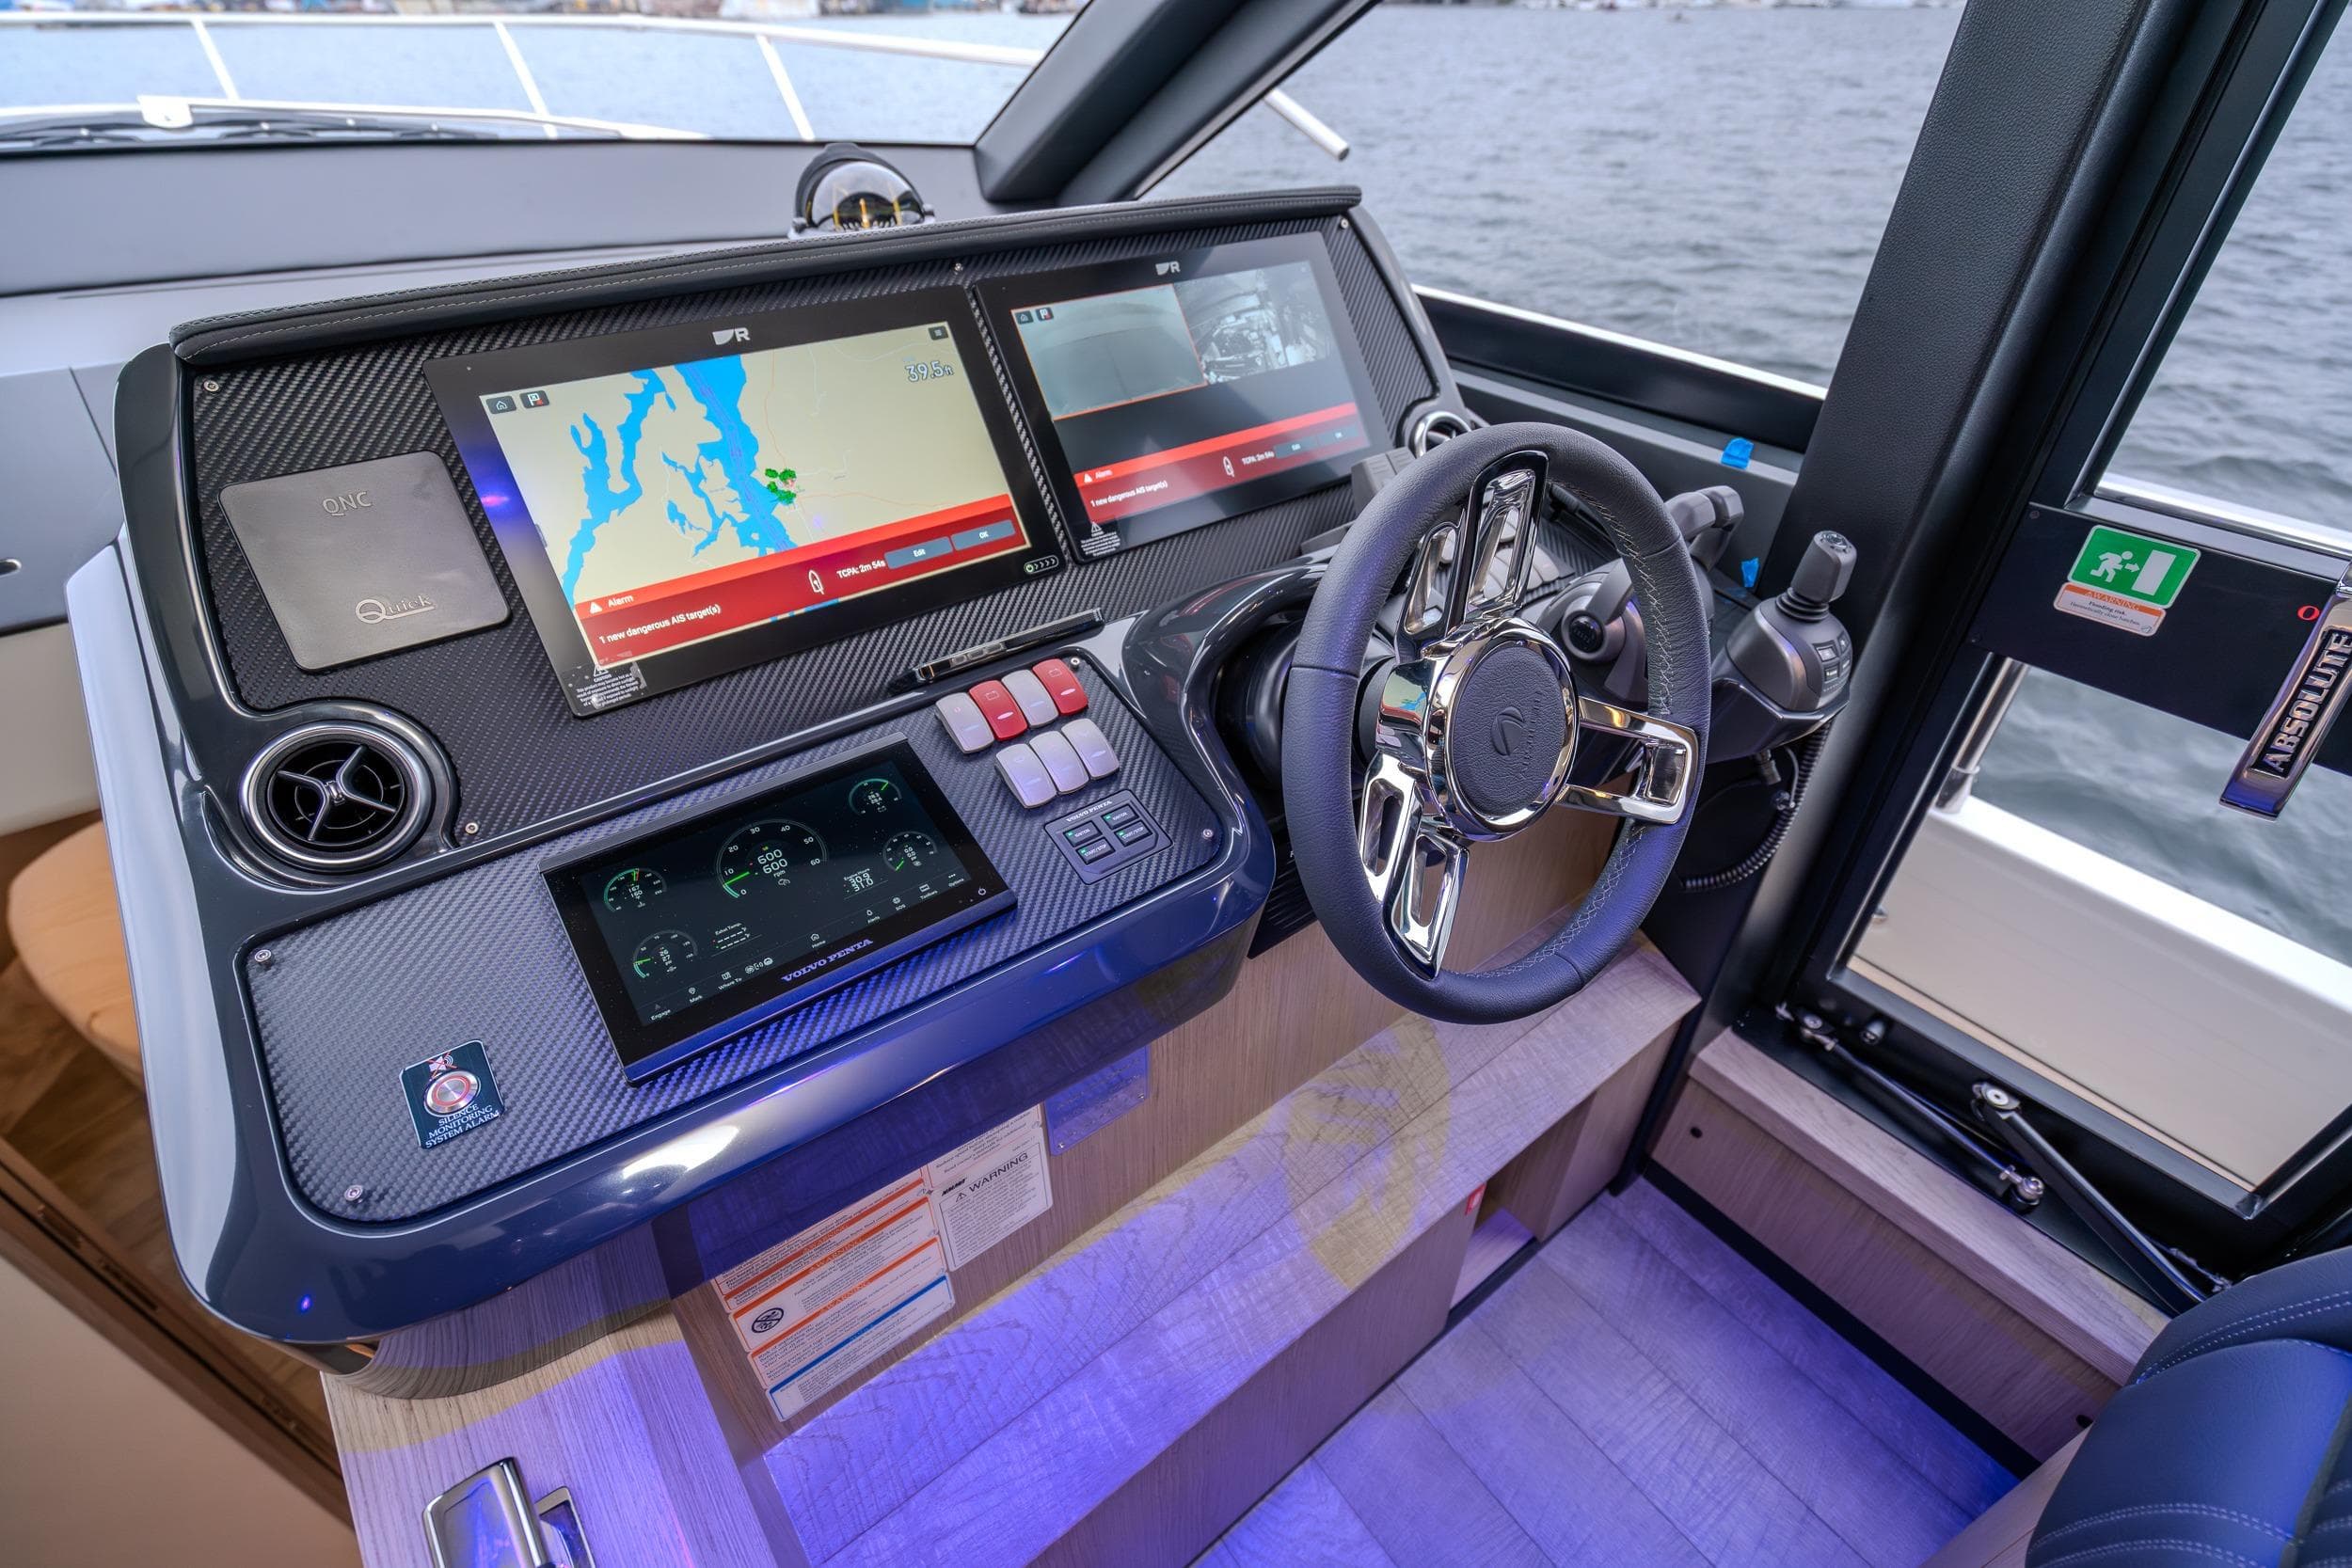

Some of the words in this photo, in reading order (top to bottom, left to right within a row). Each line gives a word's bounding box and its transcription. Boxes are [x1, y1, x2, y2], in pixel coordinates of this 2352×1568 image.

[1095, 469, 1113, 480] Alarm
[323, 491, 372, 516] QNC
[1108, 489, 1136, 503] dangerous
[913, 547, 926, 558] Edit
[836, 566, 860, 579] TCPA:
[860, 564, 872, 574] 2m
[871, 559, 886, 570] 54s
[608, 594, 633, 608] Alarm
[2091, 593, 2139, 610] WARNING
[356, 595, 436, 624] Quick
[599, 636, 606, 644] 1
[608, 632, 626, 642] new
[626, 619, 671, 638] dangerous
[671, 613, 686, 626] AIS
[686, 604, 722, 621] target(s)
[2262, 633, 2352, 773] ABSOLUTE
[1066, 810, 1089, 822] VOLVO
[1089, 800, 1112, 813] PENTA
[803, 836, 814, 845] 50
[757, 849, 783, 864] 600
[724, 868, 734, 877] 10
[762, 859, 788, 874] 600
[773, 869, 786, 878] rpm
[812, 940, 826, 948] Home
[782, 958, 827, 982] VOLVO
[827, 939, 873, 962] PENTA
[718, 980, 735, 990] Where
[690, 994, 703, 1003] Mark
[650, 1009, 671, 1021] Engage
[428, 1104, 493, 1139] MONITORING
[438, 1103, 479, 1126] SILENCE
[425, 1127, 463, 1148] SYSTEM
[465, 1110, 500, 1131] ALARM
[969, 1152, 1028, 1193] WARNING
